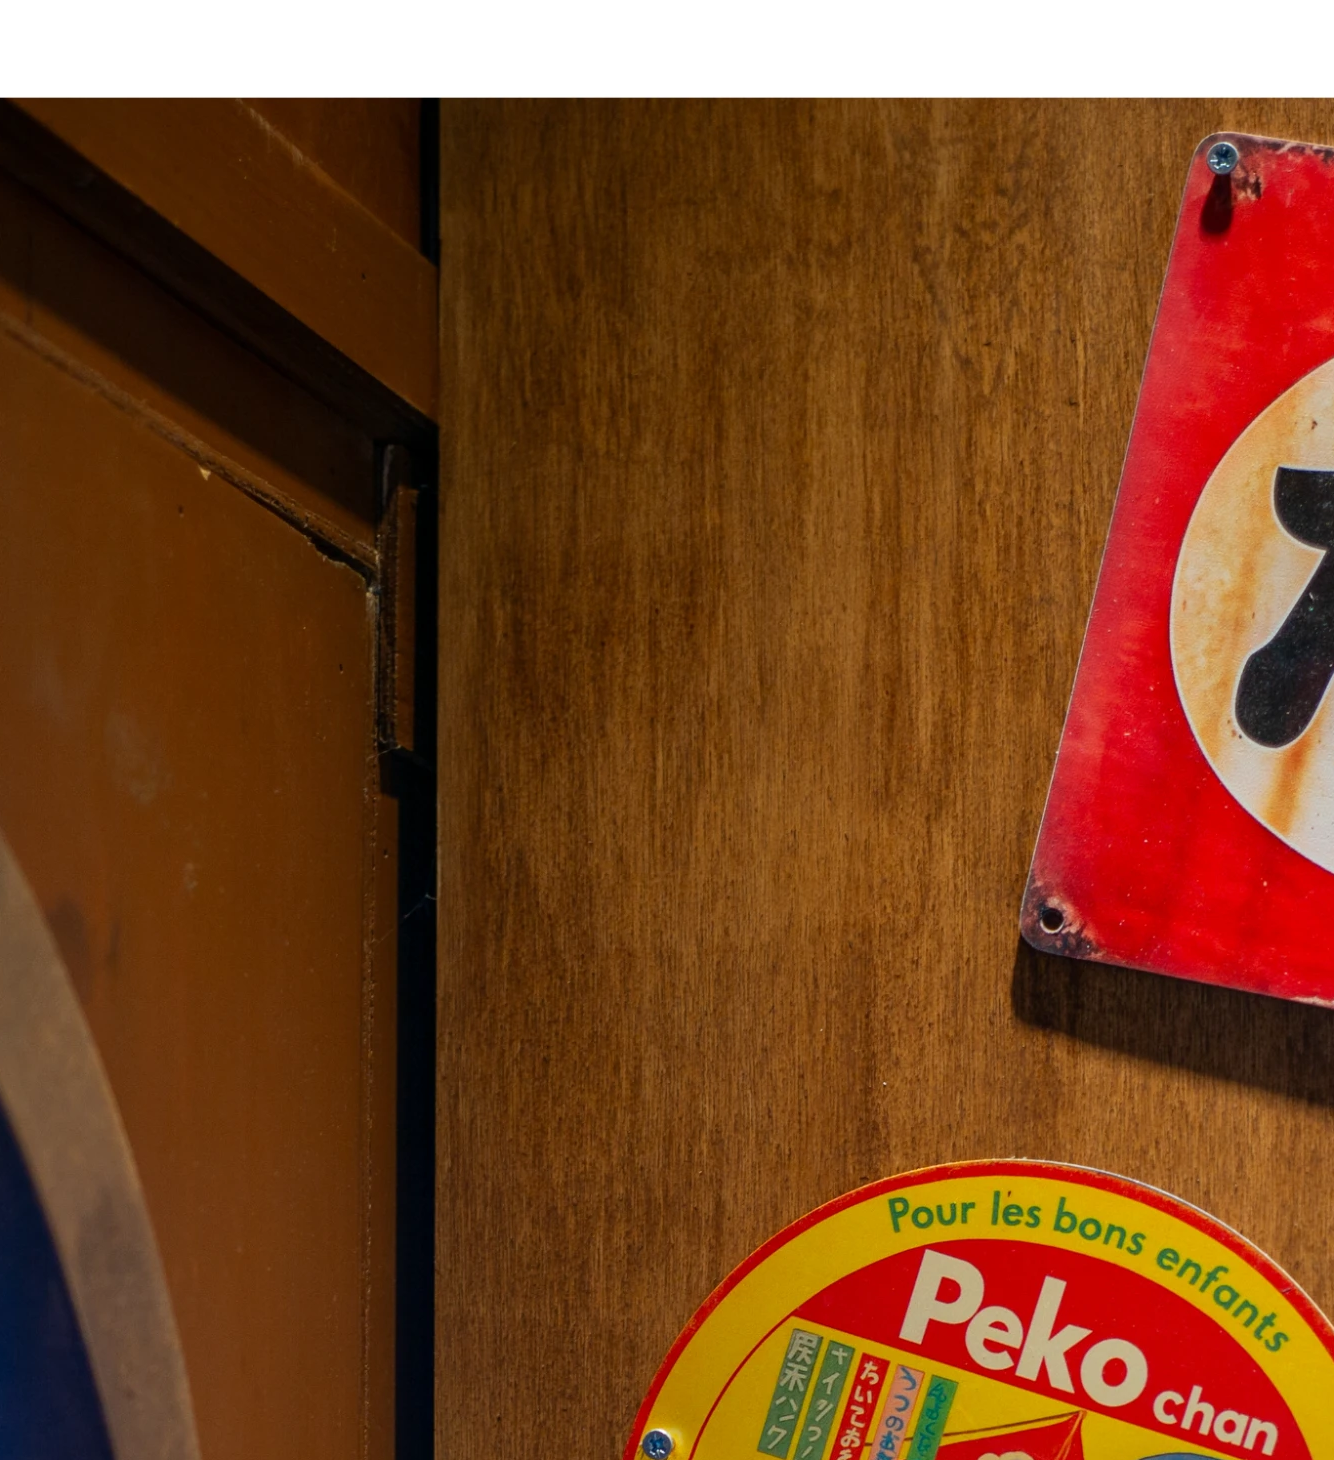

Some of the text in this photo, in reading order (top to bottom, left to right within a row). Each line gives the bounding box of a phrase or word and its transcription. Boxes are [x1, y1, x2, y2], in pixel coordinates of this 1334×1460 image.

[888, 1197, 976, 1232] Pour
[1053, 1197, 1146, 1256] bons
[1156, 1247, 1289, 1353] enfants
[899, 1248, 1278, 1455] Peko chan
